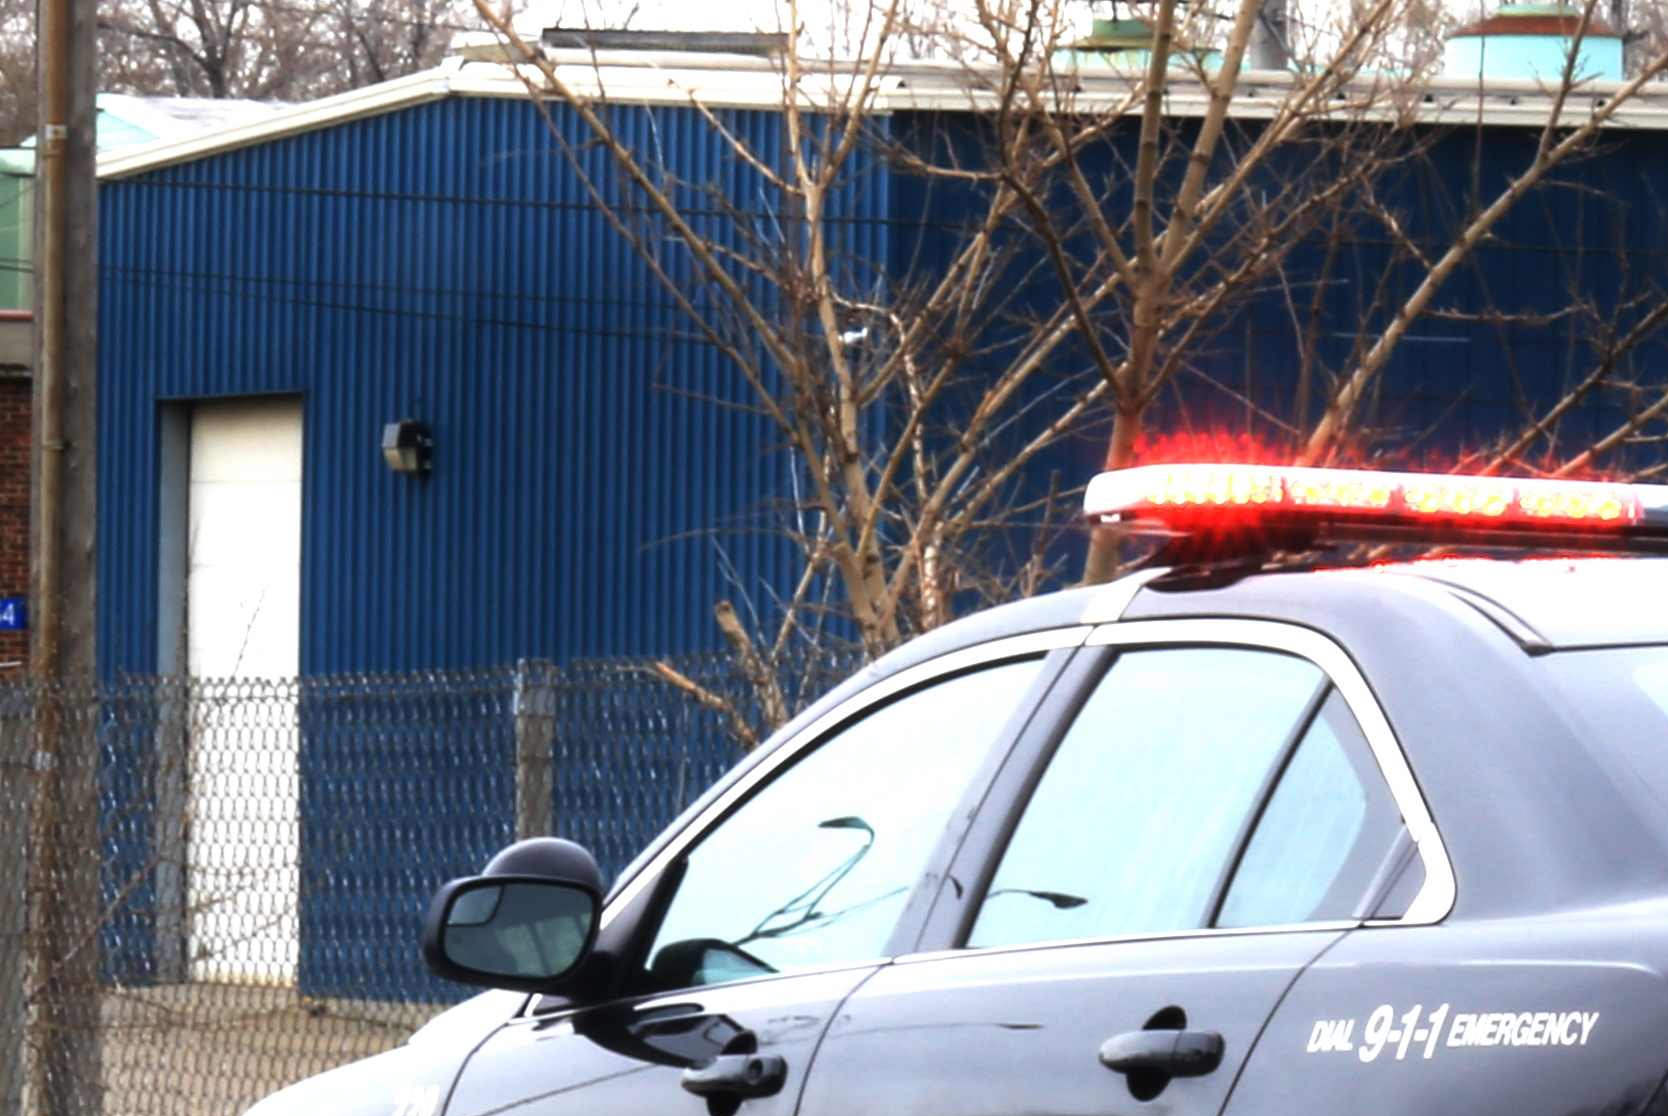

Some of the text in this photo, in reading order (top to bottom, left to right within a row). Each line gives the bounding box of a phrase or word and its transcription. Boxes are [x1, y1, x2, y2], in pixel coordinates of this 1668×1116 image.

[0, 603, 14, 626] 4
[1306, 1003, 1599, 1062] DIAL 9-1-1 EMERGENCY
